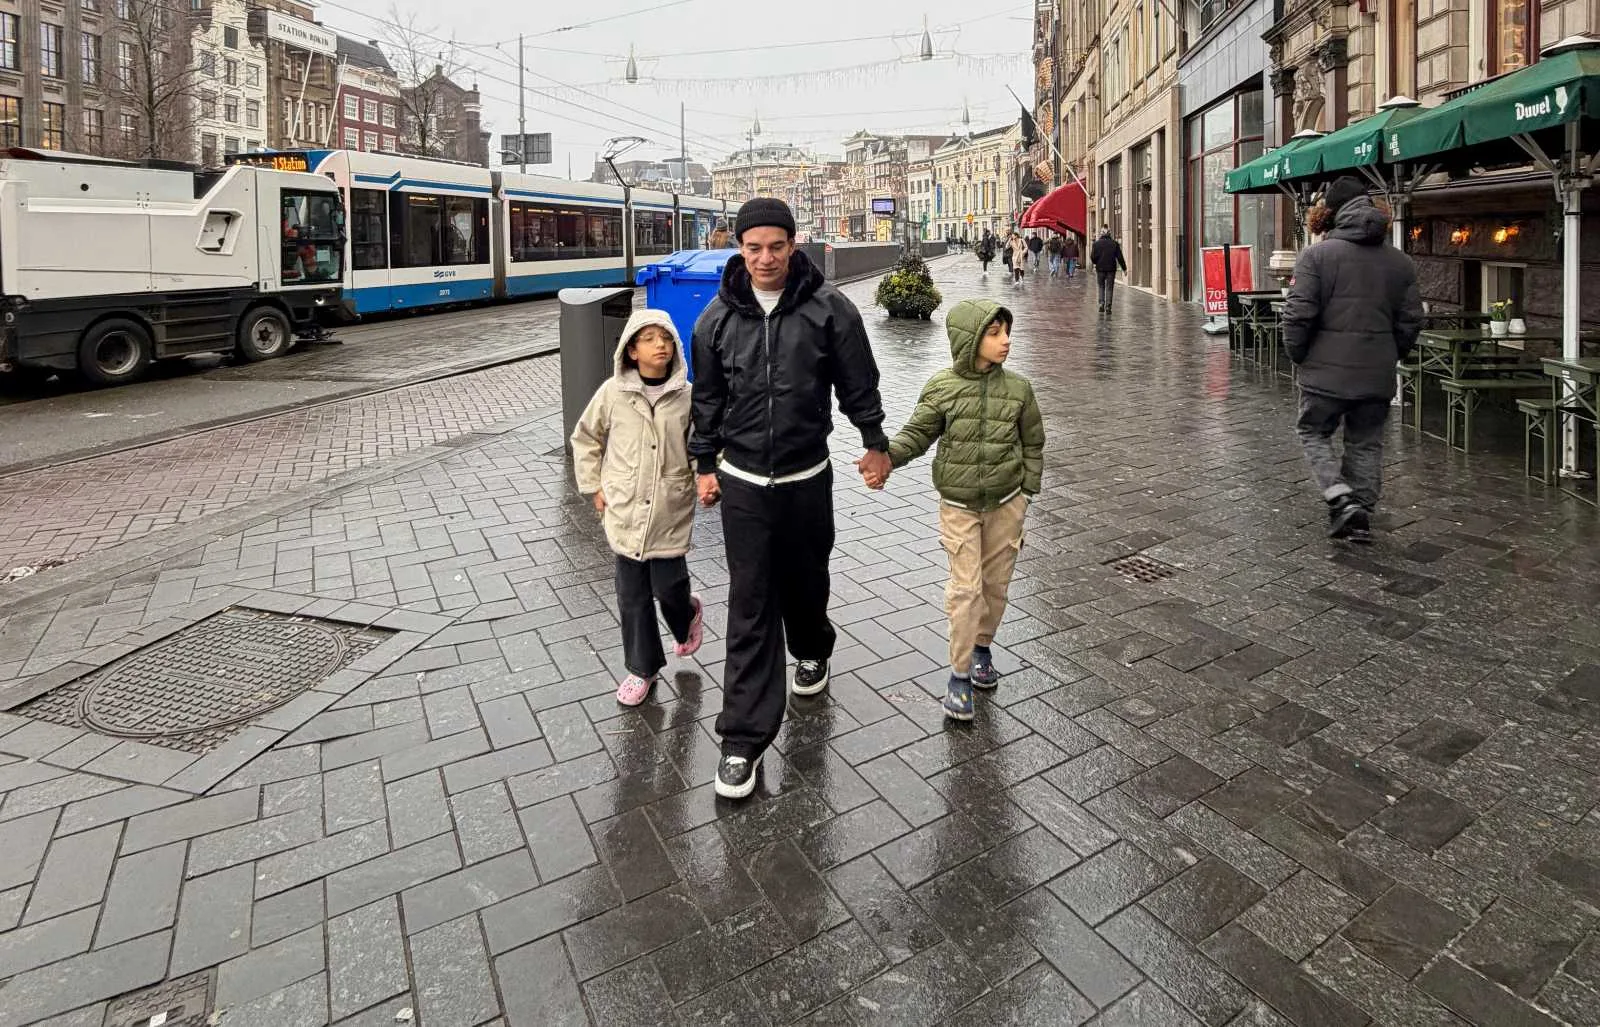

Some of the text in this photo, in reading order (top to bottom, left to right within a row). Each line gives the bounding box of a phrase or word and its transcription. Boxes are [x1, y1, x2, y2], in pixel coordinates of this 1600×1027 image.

[278, 23, 307, 39] STATION
[1514, 94, 1551, 121] Duvel
[279, 157, 306, 171] Station
